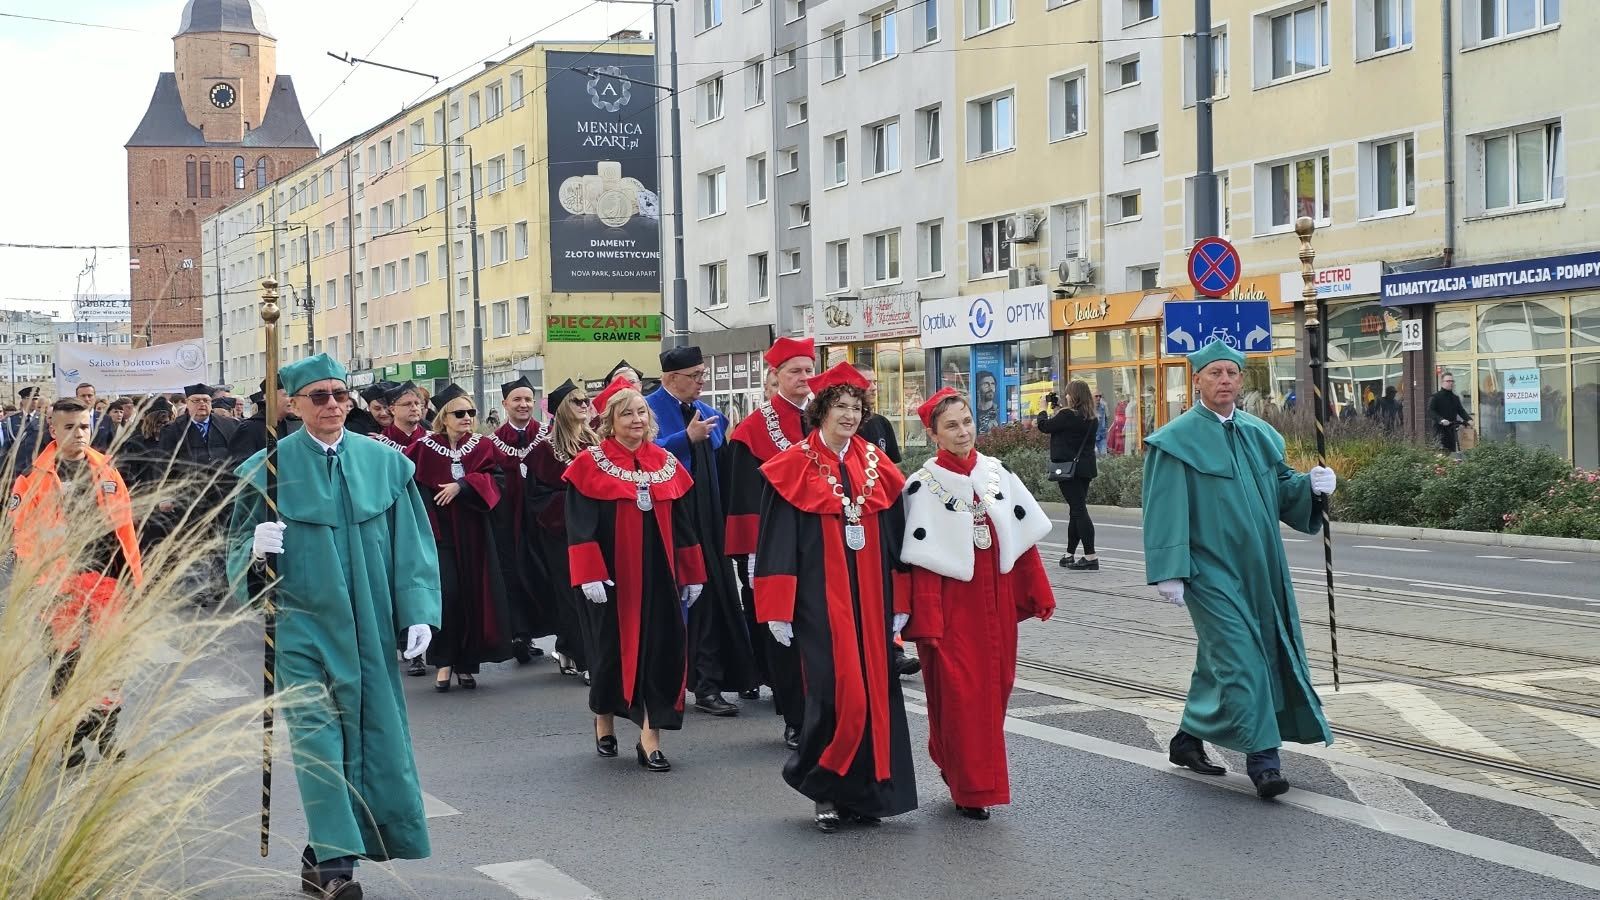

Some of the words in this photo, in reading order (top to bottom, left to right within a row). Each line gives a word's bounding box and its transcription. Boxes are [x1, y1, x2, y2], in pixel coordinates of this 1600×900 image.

[577, 121, 643, 135] MENNICA
[582, 135, 640, 150] APART.pl
[590, 239, 636, 248] DIAMENTY
[565, 250, 595, 259] ZŁOTO
[596, 249, 660, 259] INWESTYCYJNE
[591, 270, 611, 278] PARK,
[636, 269, 657, 277] APART
[1312, 268, 1351, 285] LECTRO
[1385, 279, 1467, 297] KLIMATYZACJA
[1472, 267, 1551, 289] WENTYLACJA
[1556, 261, 1600, 280] POMPY
[1333, 283, 1352, 292] CLIM
[1006, 302, 1045, 323] OPTYK
[547, 315, 647, 331] PIECZĄTKI
[923, 310, 956, 334] Optilux
[593, 332, 641, 341] GRAWER
[1405, 323, 1419, 339] 18
[89, 359, 120, 367] Szkoła
[123, 358, 171, 367] Doktorska
